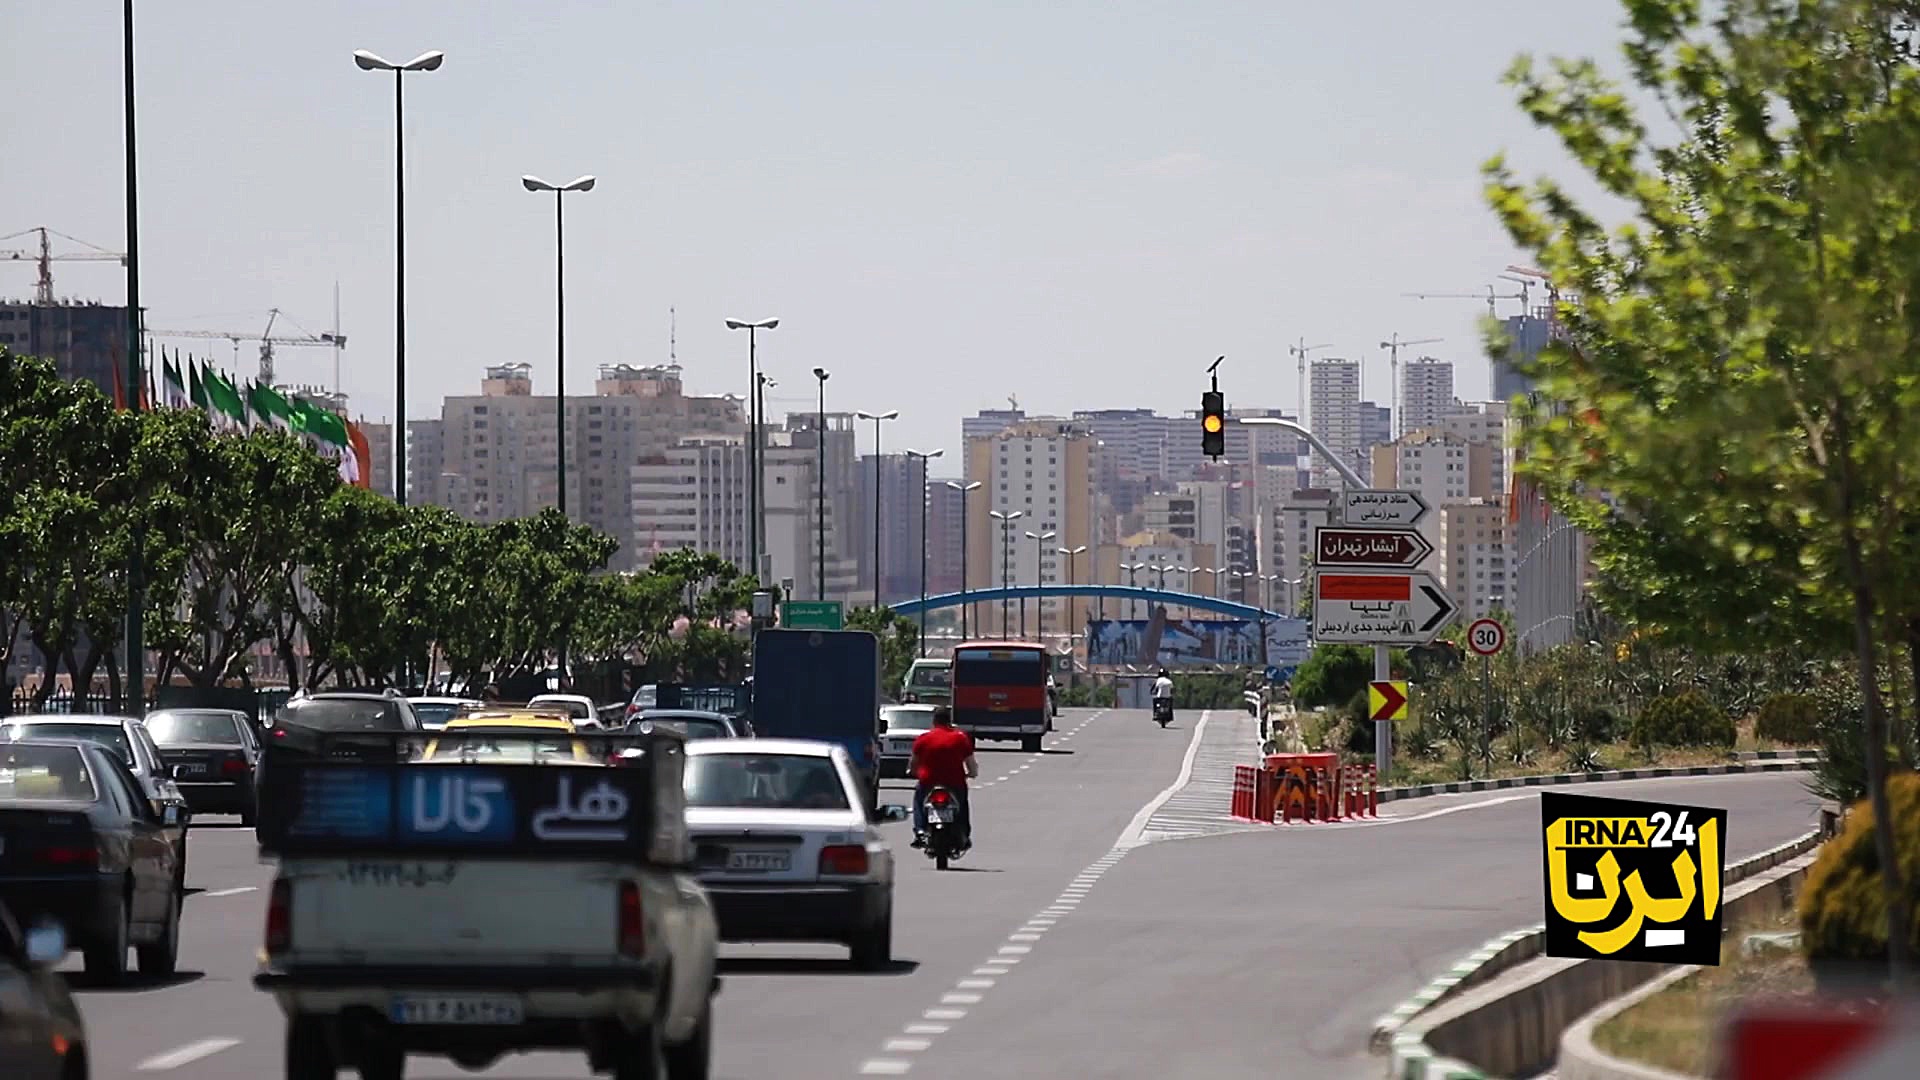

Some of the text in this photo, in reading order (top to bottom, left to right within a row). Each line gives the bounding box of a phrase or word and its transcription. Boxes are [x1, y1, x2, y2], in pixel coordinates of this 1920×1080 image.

[1349, 494, 1388, 507] فرماندهی
[1324, 535, 1400, 558] آبشار تهران
[1476, 630, 1496, 646] 30
[411, 775, 506, 833] کالا
